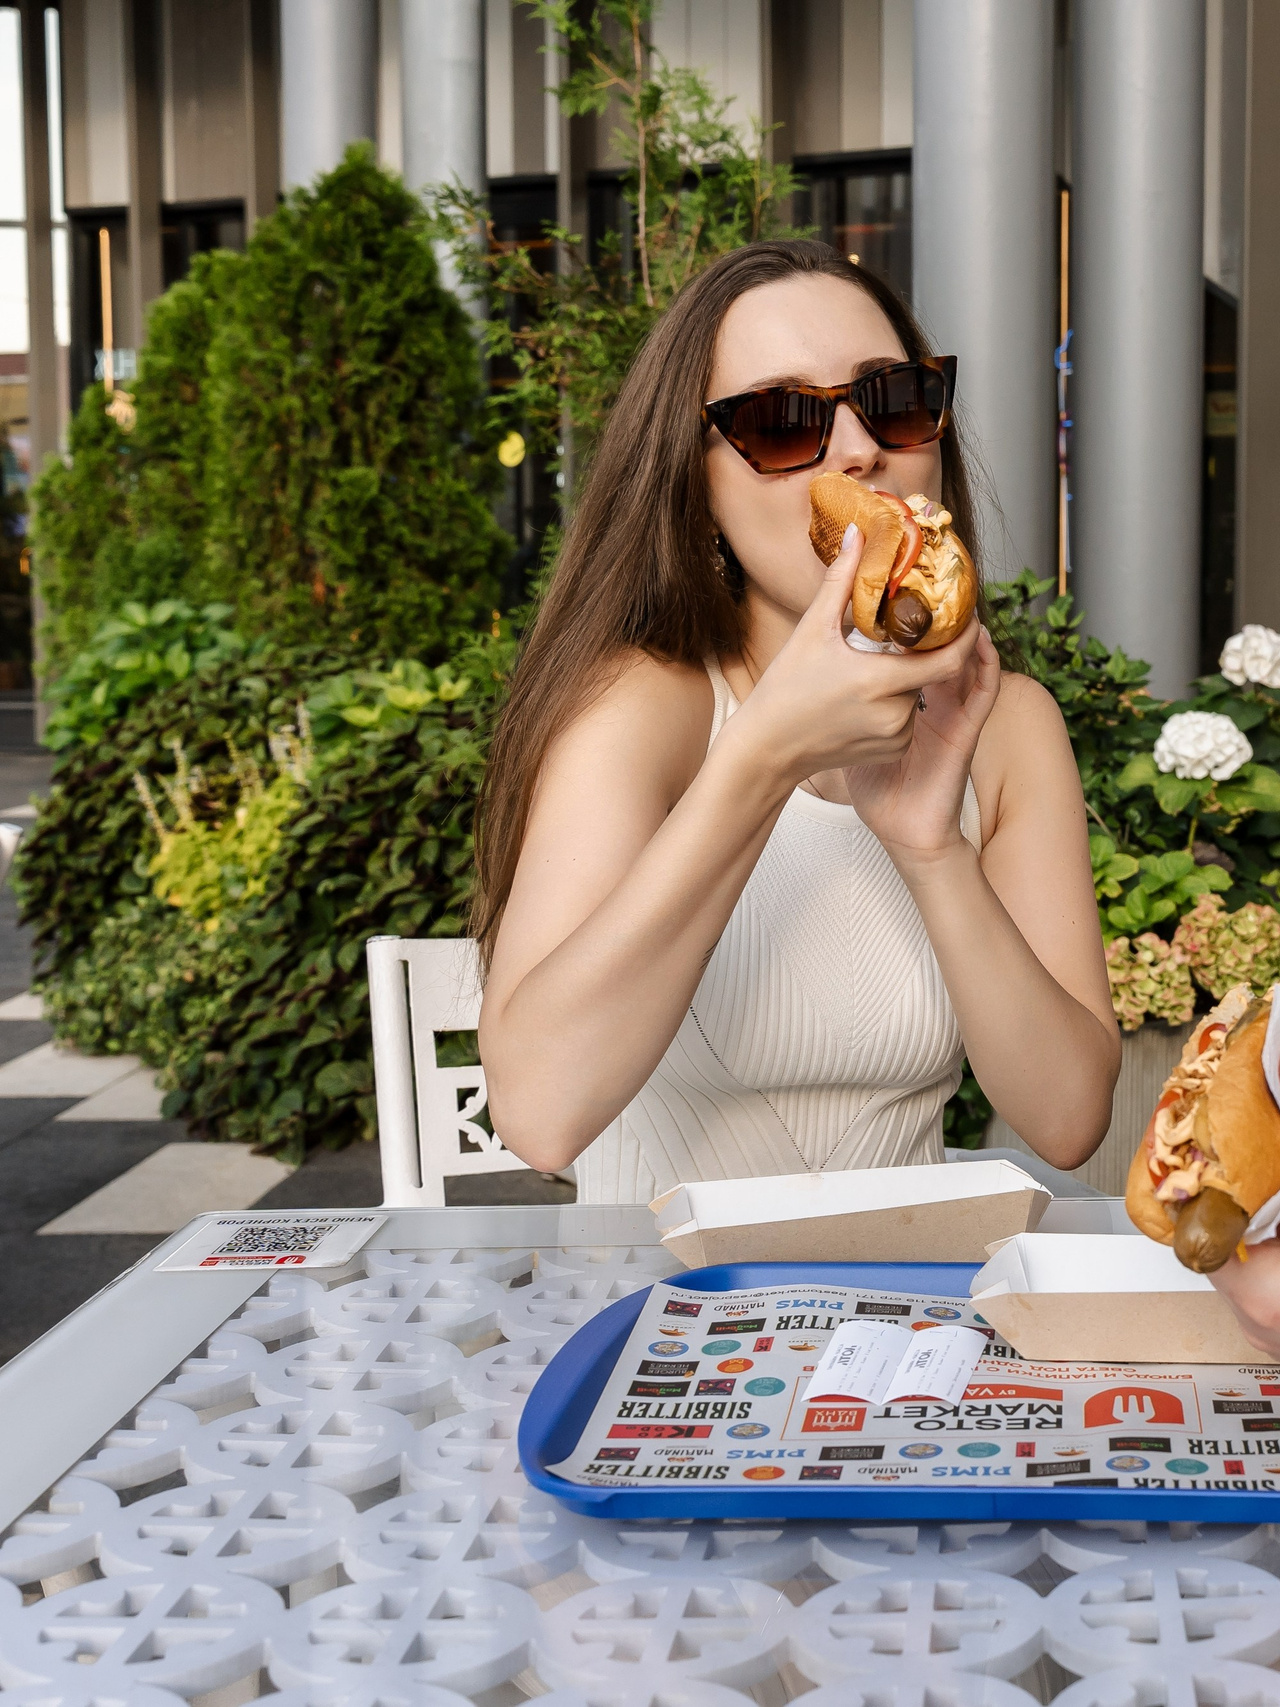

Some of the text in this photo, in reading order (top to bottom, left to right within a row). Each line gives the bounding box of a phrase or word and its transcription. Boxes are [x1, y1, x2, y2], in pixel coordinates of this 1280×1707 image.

[670, 1289, 847, 1300] Restomarket@resproject.ru
[714, 1302, 765, 1312] MARINAD
[776, 1299, 845, 1310] PIMS
[1007, 1368, 1101, 1379] НАПИТКИ
[616, 1402, 752, 1419] SIBBITTER
[873, 1403, 1062, 1418] MARKET
[914, 1417, 1062, 1431] RESTO
[668, 1426, 696, 1438] K
[726, 1448, 806, 1459] PIMS
[584, 1464, 730, 1480] SIBBITTER
[932, 1466, 1011, 1476] PIMS
